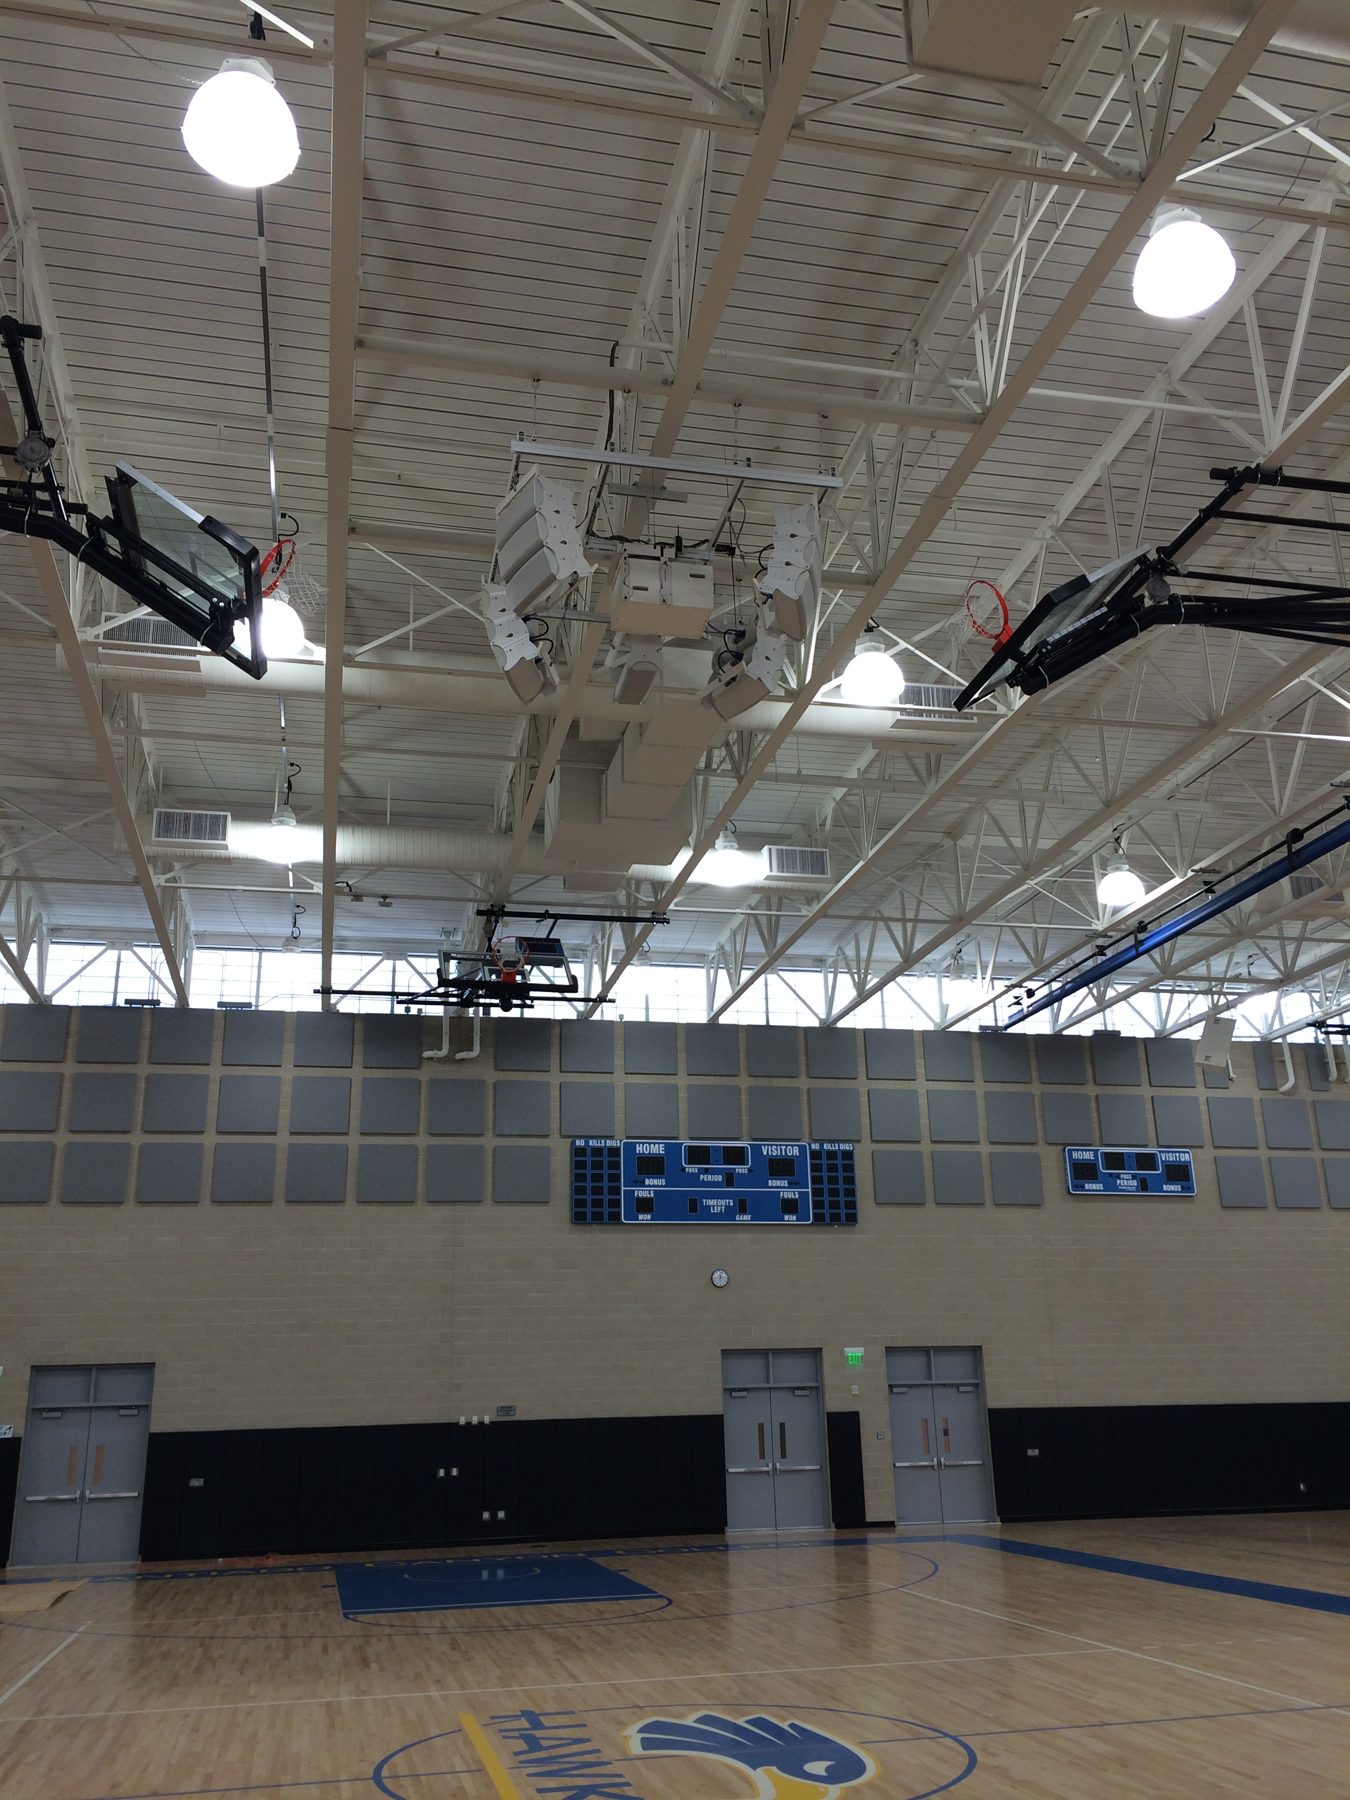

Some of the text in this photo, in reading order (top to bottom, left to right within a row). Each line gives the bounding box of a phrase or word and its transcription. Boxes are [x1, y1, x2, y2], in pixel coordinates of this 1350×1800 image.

[636, 1144, 665, 1154] HOME
[762, 1145, 799, 1156] VISITOR
[1072, 1151, 1094, 1160] HOME
[1160, 1152, 1191, 1162] VISITOR
